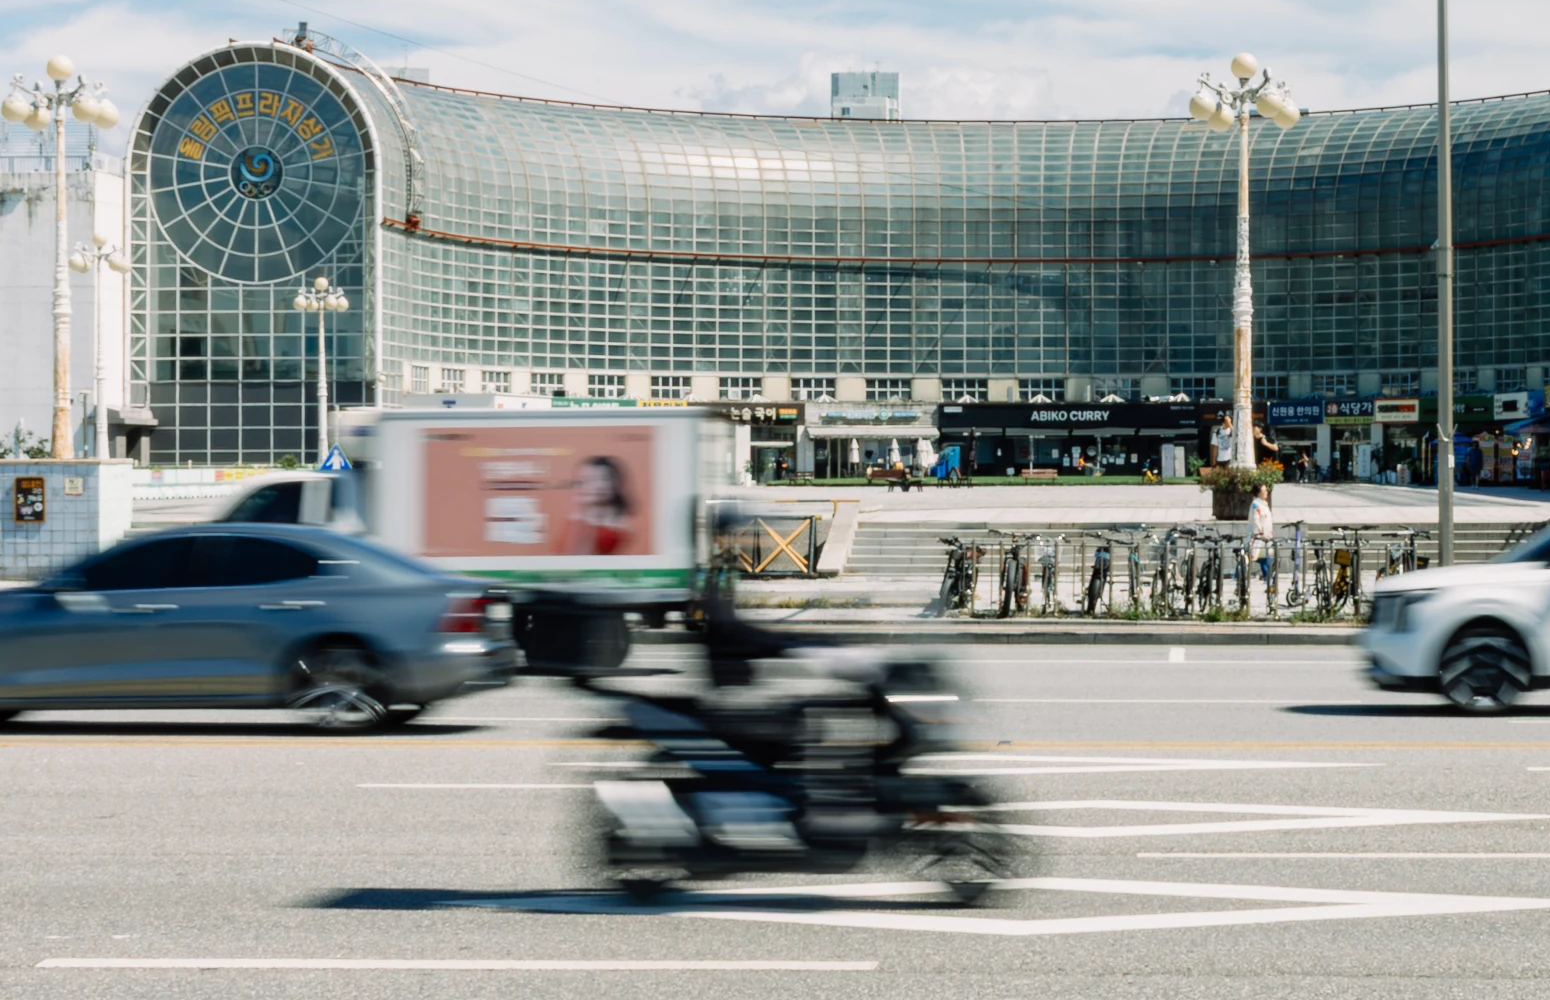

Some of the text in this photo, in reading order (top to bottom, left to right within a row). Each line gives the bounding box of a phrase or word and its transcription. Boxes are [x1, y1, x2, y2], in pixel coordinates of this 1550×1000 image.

[180, 92, 333, 161] 올림픽프라자상가
[1296, 405, 1321, 417] 한의원
[1340, 402, 1373, 415] 식당가
[1031, 410, 1110, 421] ABIKO CURRY
